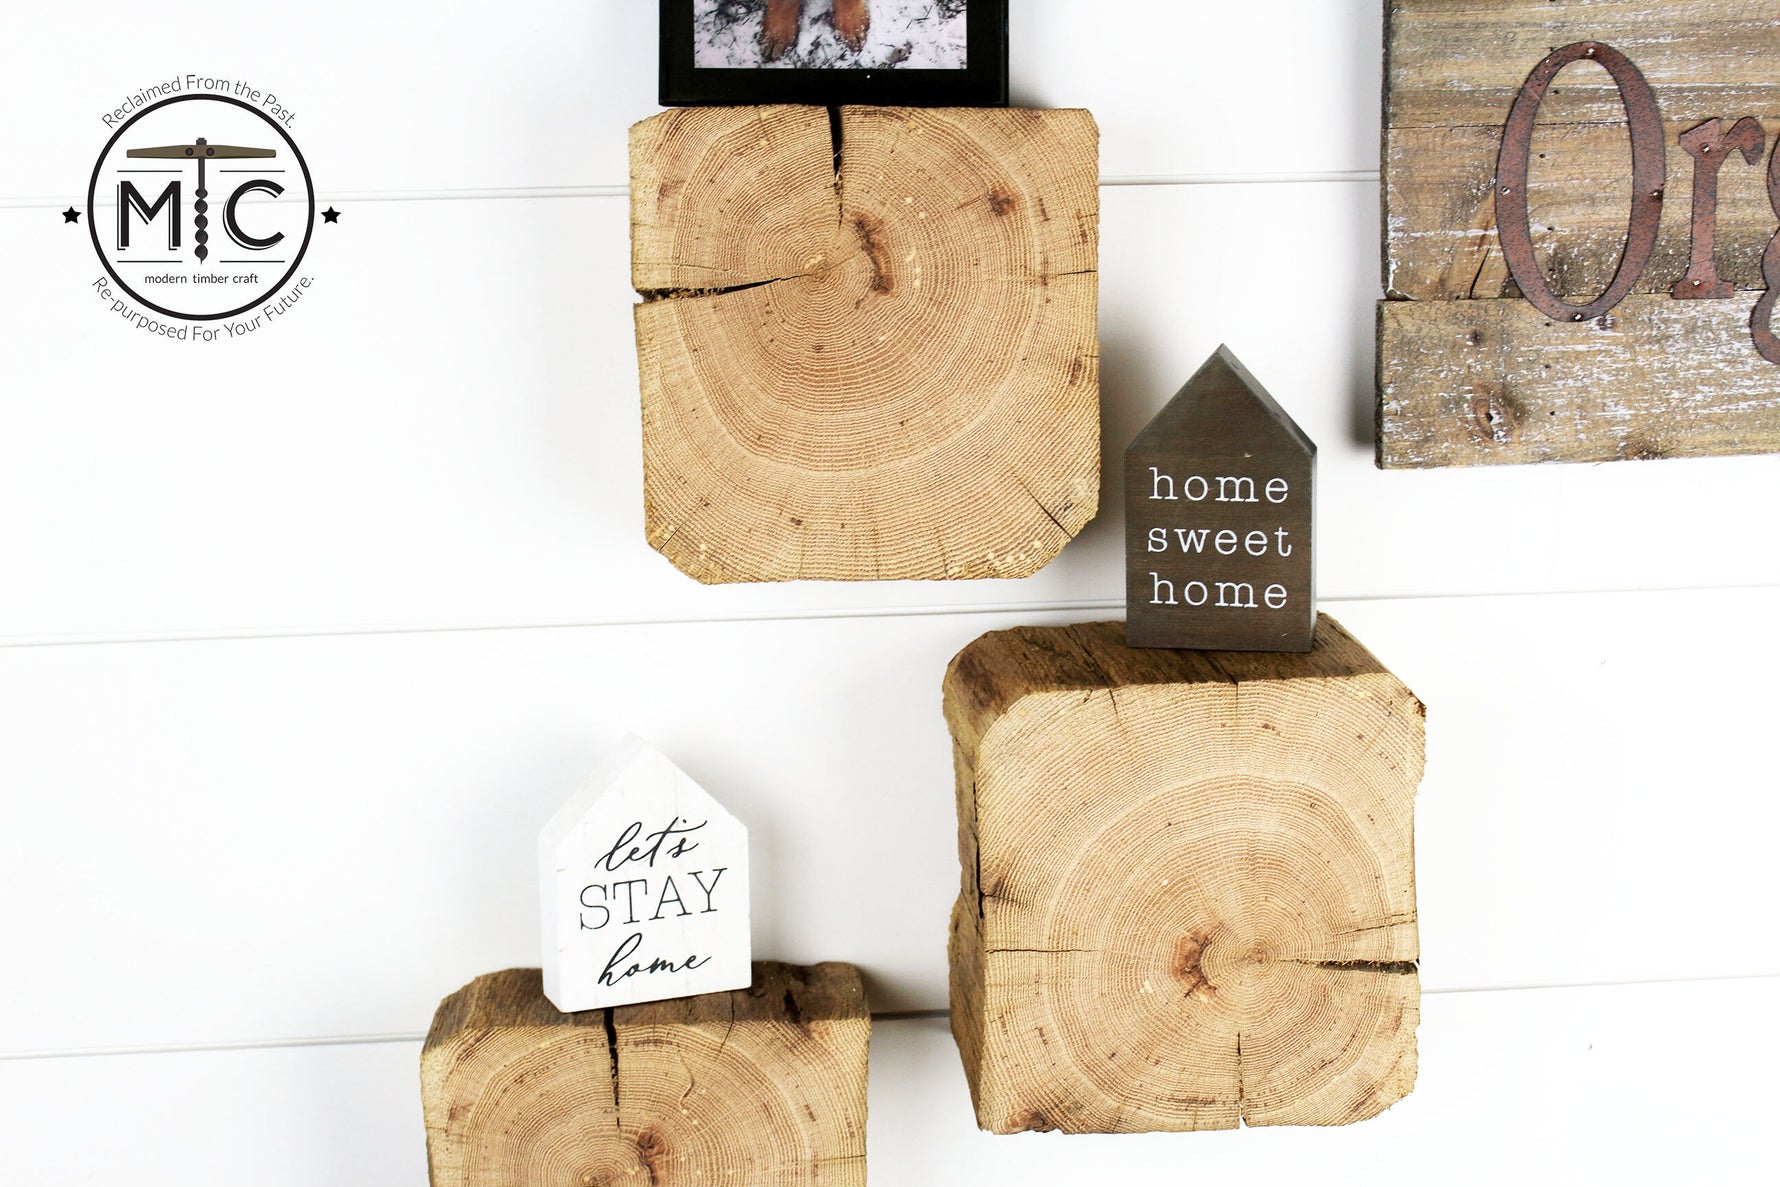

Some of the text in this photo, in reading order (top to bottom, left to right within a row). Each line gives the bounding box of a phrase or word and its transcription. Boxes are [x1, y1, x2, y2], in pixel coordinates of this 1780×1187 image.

[1148, 466, 1289, 503] home
[1147, 526, 1293, 557] sweet
[1148, 571, 1288, 609] home
[594, 816, 708, 872] let's
[579, 867, 728, 930] STAY
[597, 932, 712, 987] home
